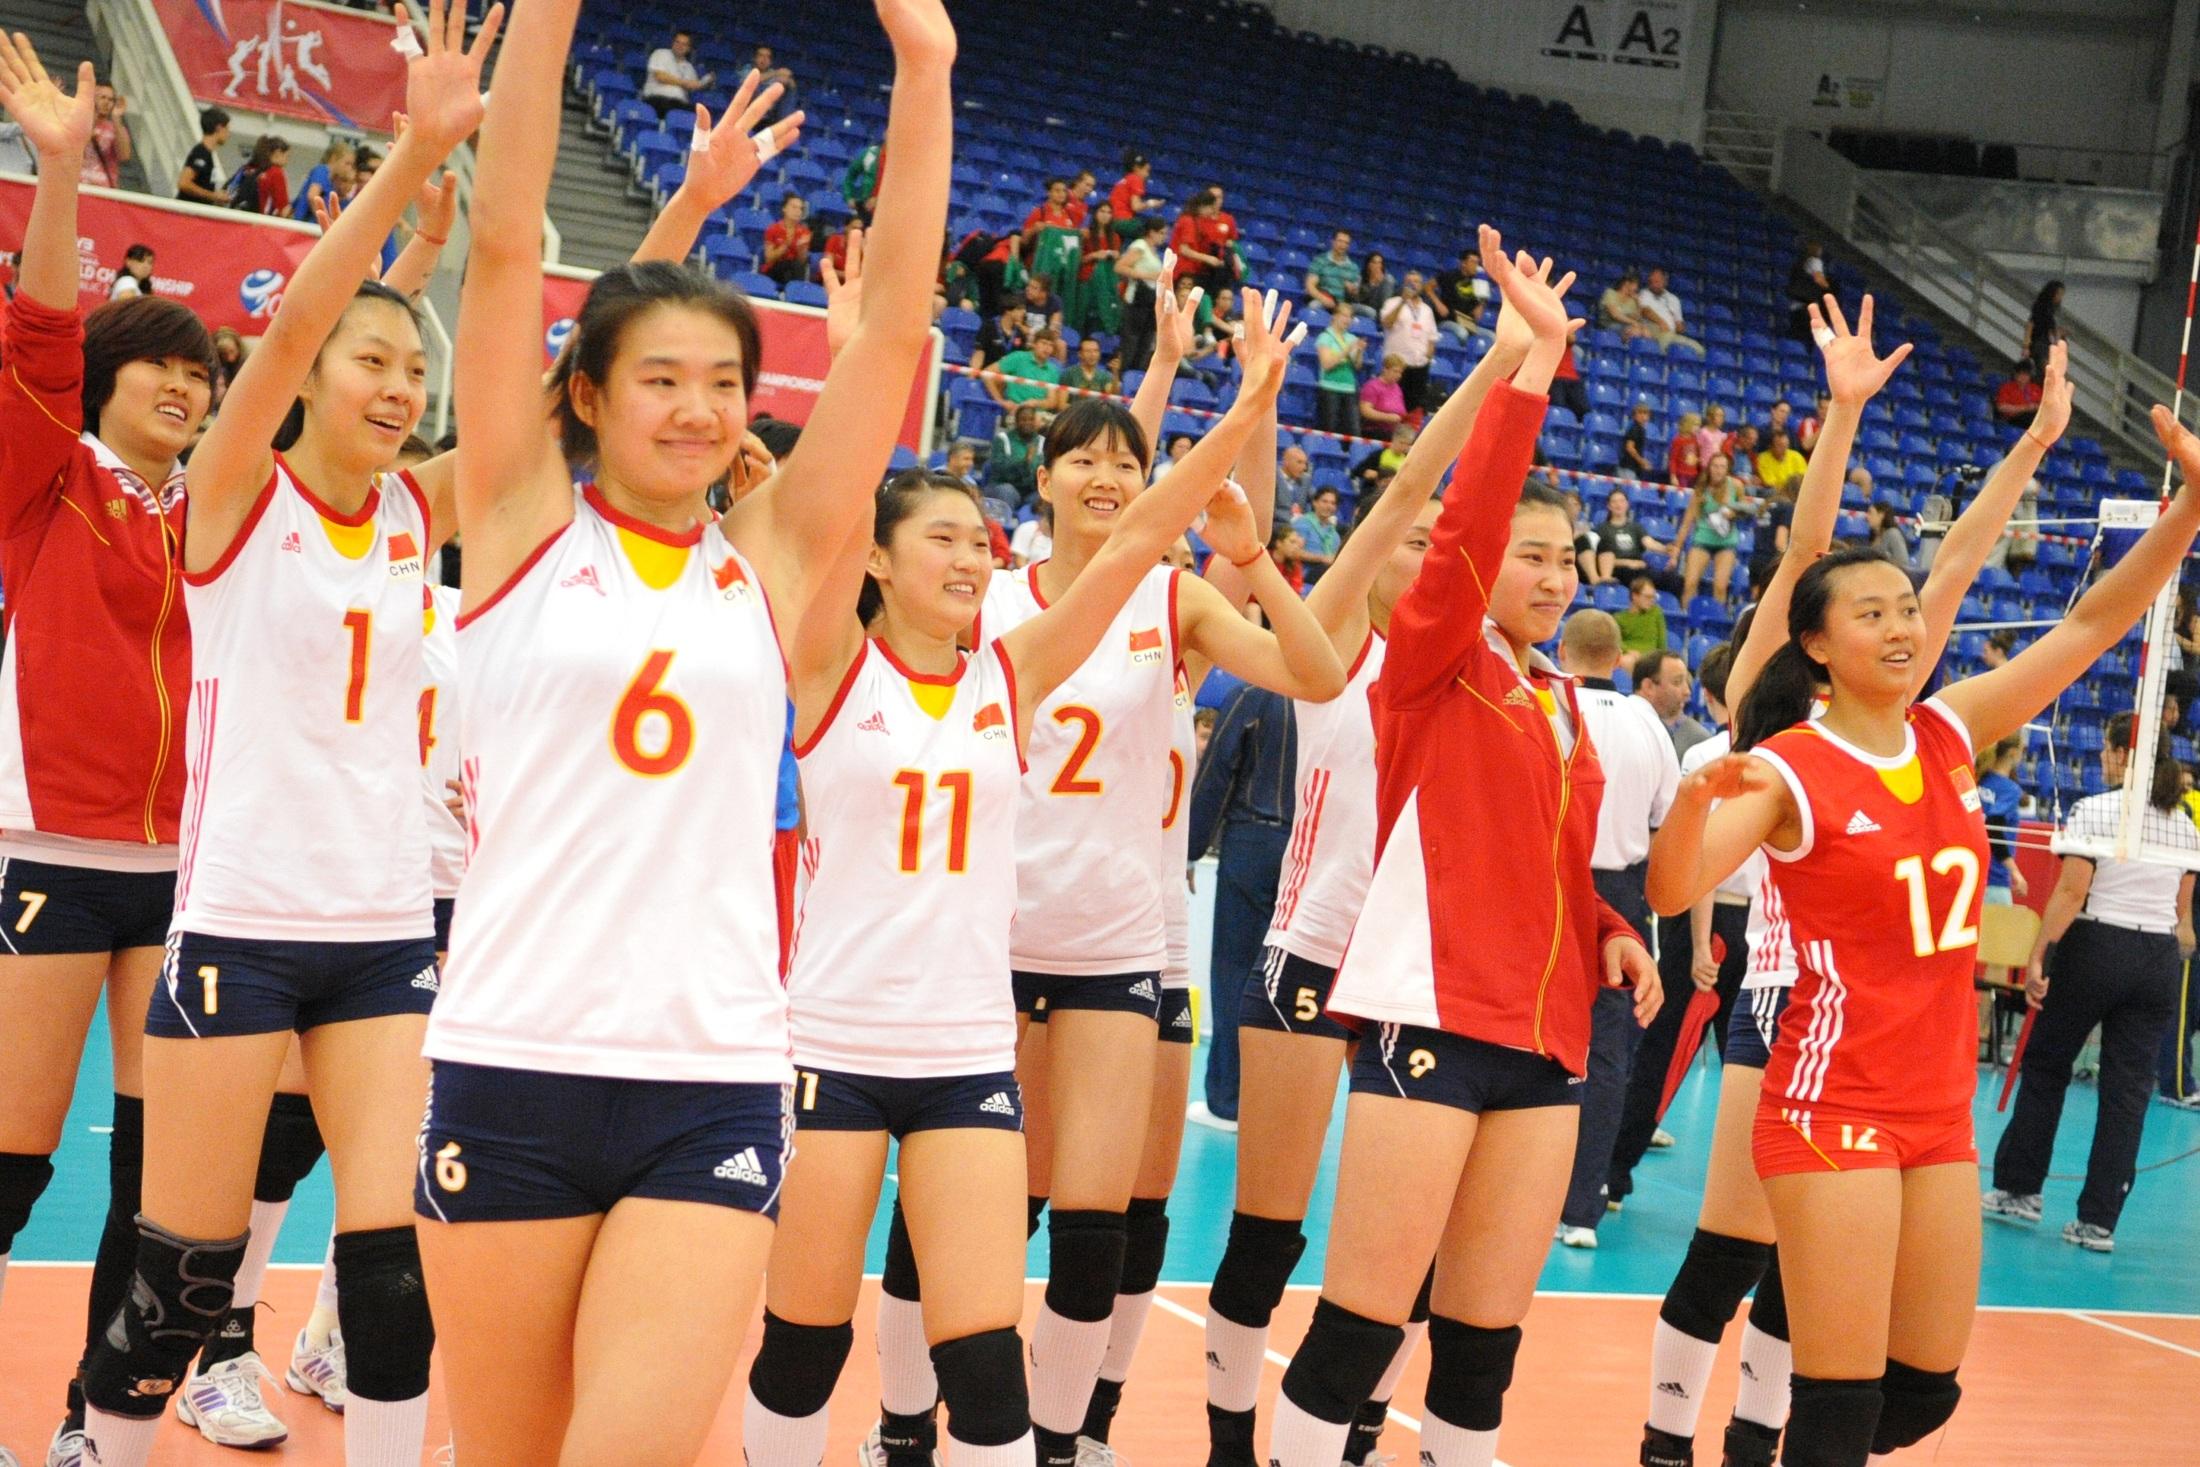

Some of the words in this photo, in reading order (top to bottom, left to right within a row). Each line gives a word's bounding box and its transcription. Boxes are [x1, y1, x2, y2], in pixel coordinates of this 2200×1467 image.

[1555, 4, 1594, 47] A
[1618, 10, 1681, 55] A2
[389, 560, 420, 577] CHN
[343, 609, 372, 724] 1
[1134, 651, 1161, 663] CHN
[610, 650, 696, 778] 6
[983, 729, 1008, 741] CHN
[1050, 706, 1104, 795] 2
[892, 769, 973, 874] 11
[1845, 823, 1882, 836] adidas
[15, 891, 47, 934] 7
[1895, 847, 1980, 957] 12
[198, 966, 219, 1014] 1
[1128, 986, 1157, 1002] adidas
[1295, 987, 1318, 1021] 5
[979, 1102, 1016, 1117] adidas
[436, 1140, 467, 1192] 6
[712, 1165, 768, 1187] adidas
